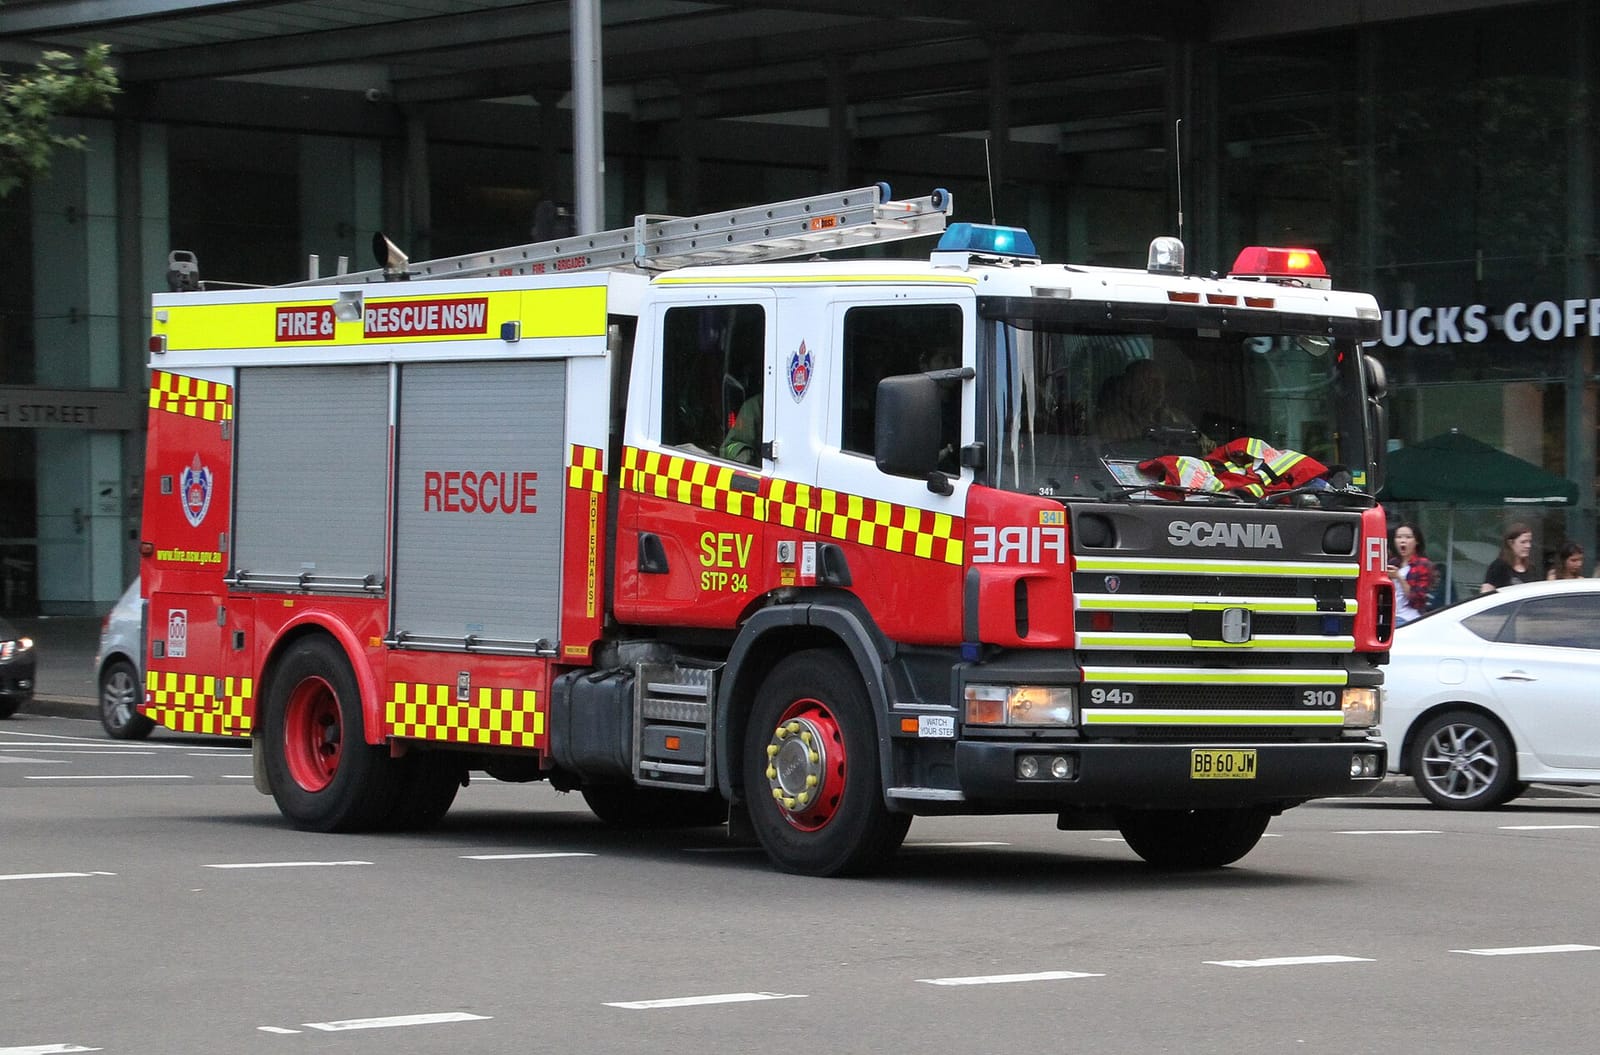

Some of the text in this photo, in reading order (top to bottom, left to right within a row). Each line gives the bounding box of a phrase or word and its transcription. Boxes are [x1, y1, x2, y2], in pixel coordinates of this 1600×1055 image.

[532, 263, 545, 274] FIRE
[557, 256, 585, 271] BRIGADES
[277, 303, 486, 336] FIRE & RESCUE NSW
[19, 404, 98, 424] STREET
[424, 471, 538, 514] RESCUE
[1039, 487, 1054, 496] 341
[1042, 511, 1063, 524] 341
[1167, 520, 1284, 549] SCANIA
[700, 531, 753, 569] SEV
[1366, 536, 1388, 572] FI
[588, 535, 596, 611] EXHAUST
[701, 571, 748, 593] STP 34
[1091, 688, 1134, 704] 94D
[1302, 690, 1336, 706] 310
[920, 727, 955, 736] YOUR STEP
[927, 718, 947, 727] WATCH
